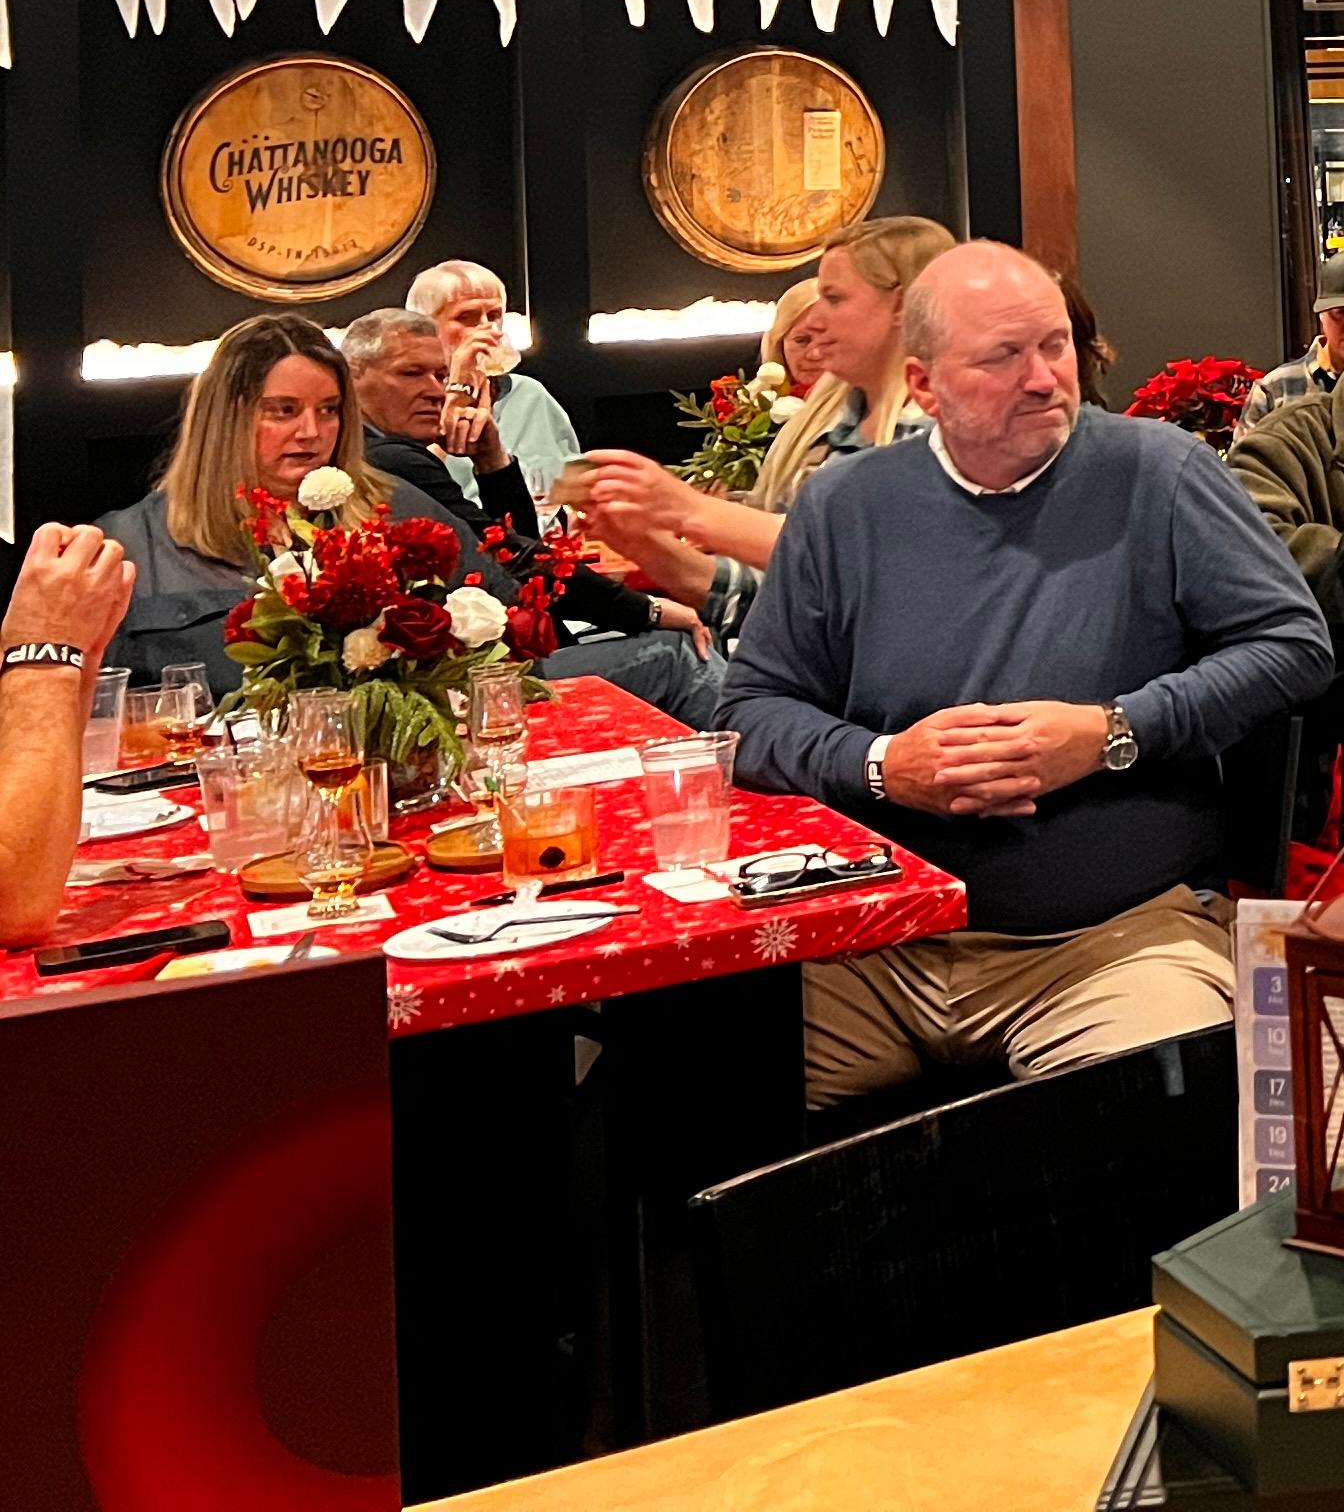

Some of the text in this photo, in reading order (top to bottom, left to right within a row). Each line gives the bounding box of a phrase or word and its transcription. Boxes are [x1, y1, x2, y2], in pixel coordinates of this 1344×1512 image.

[209, 136, 403, 194] CHATTANOOGA
[245, 166, 372, 215] WHISKEY
[868, 762, 886, 800] VIP
[1270, 975, 1282, 994] 3
[1268, 1027, 1286, 1045] 10
[1269, 1078, 1286, 1097] 17
